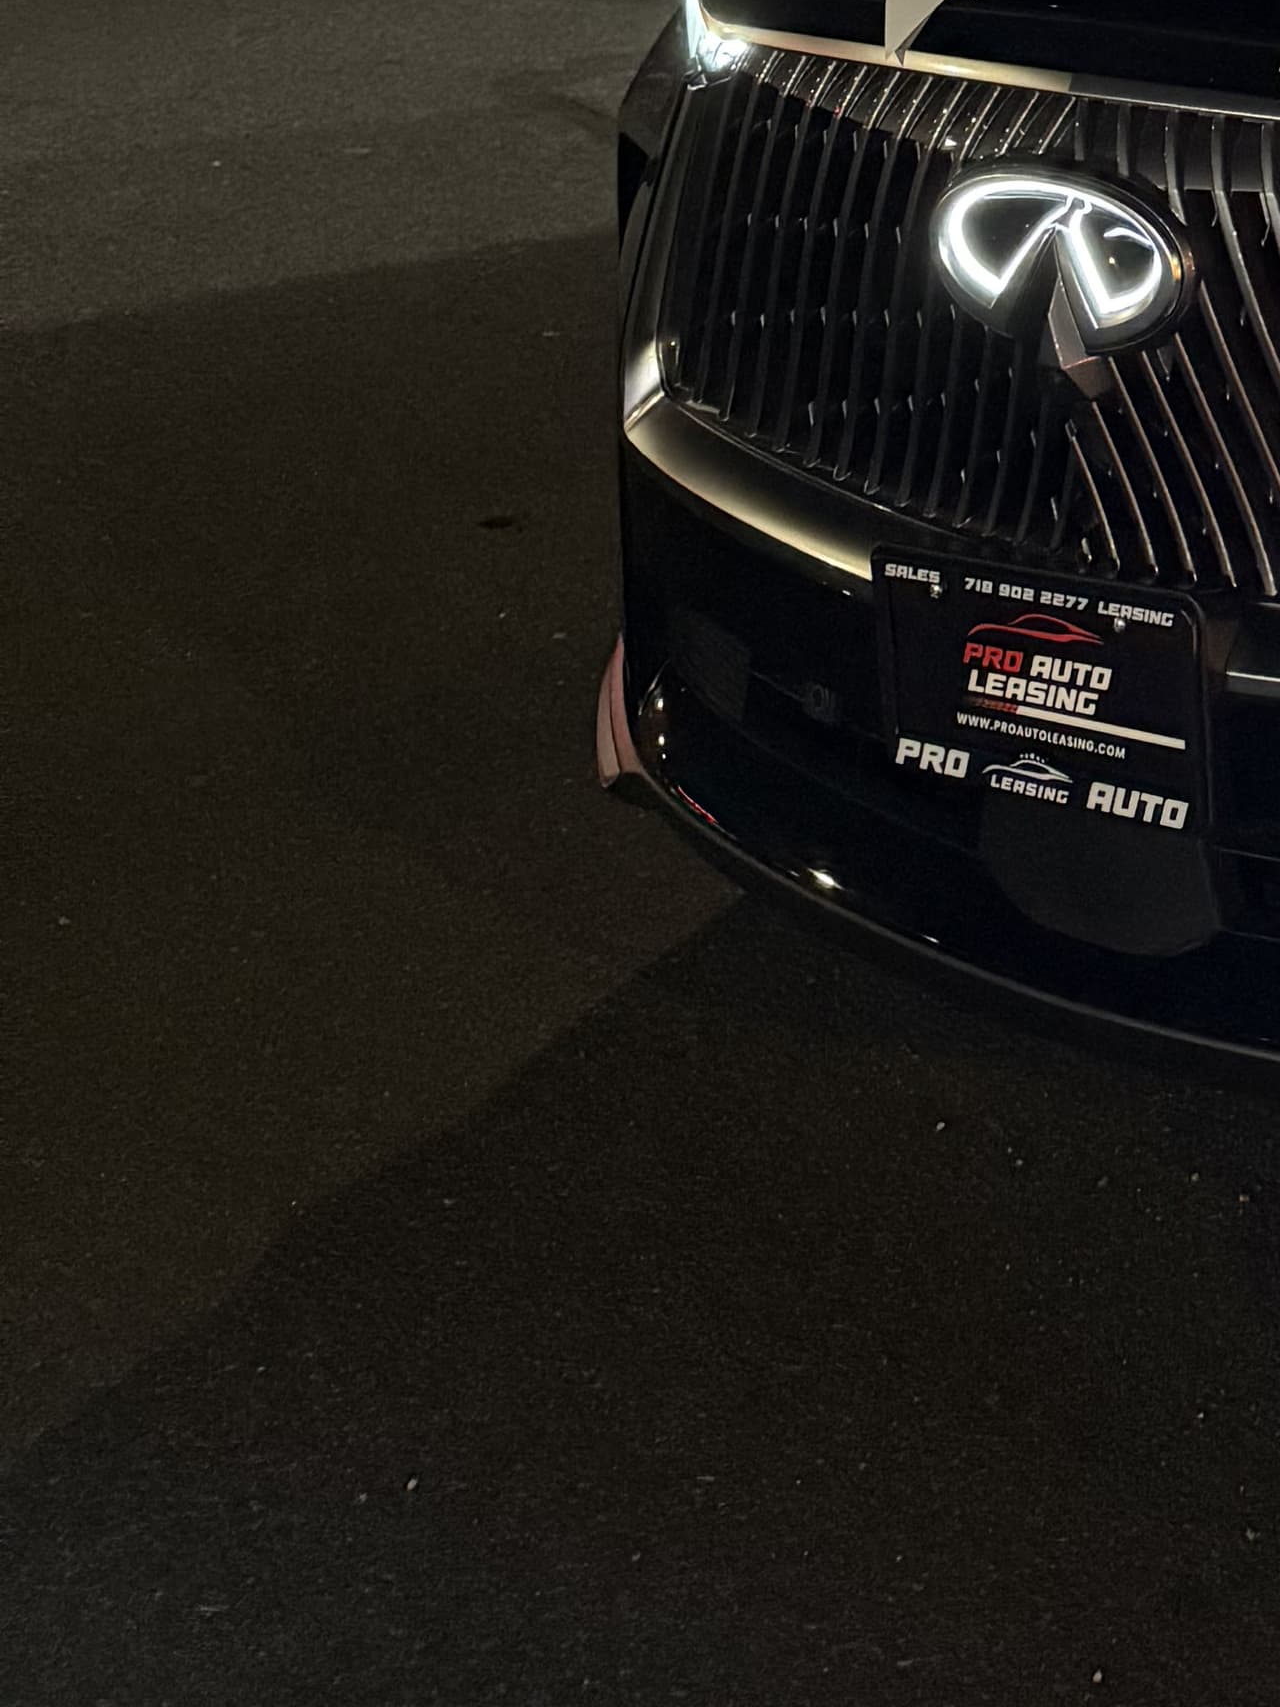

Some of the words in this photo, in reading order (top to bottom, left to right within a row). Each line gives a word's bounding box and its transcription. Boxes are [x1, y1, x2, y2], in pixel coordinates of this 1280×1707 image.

[884, 563, 940, 583] SALES
[964, 577, 993, 594] 718
[998, 583, 1034, 601] 902
[1039, 589, 1089, 610] 2277
[1097, 600, 1174, 627] LEASING
[962, 642, 1024, 673] PRO
[1030, 655, 1113, 691] AUTO
[967, 668, 1099, 716] LEASING
[895, 737, 970, 778] PRO
[956, 711, 1126, 759] WWW.PROAUTOLEASING.COM
[990, 773, 1069, 804] LEASING
[1086, 781, 1189, 829] AUTO
